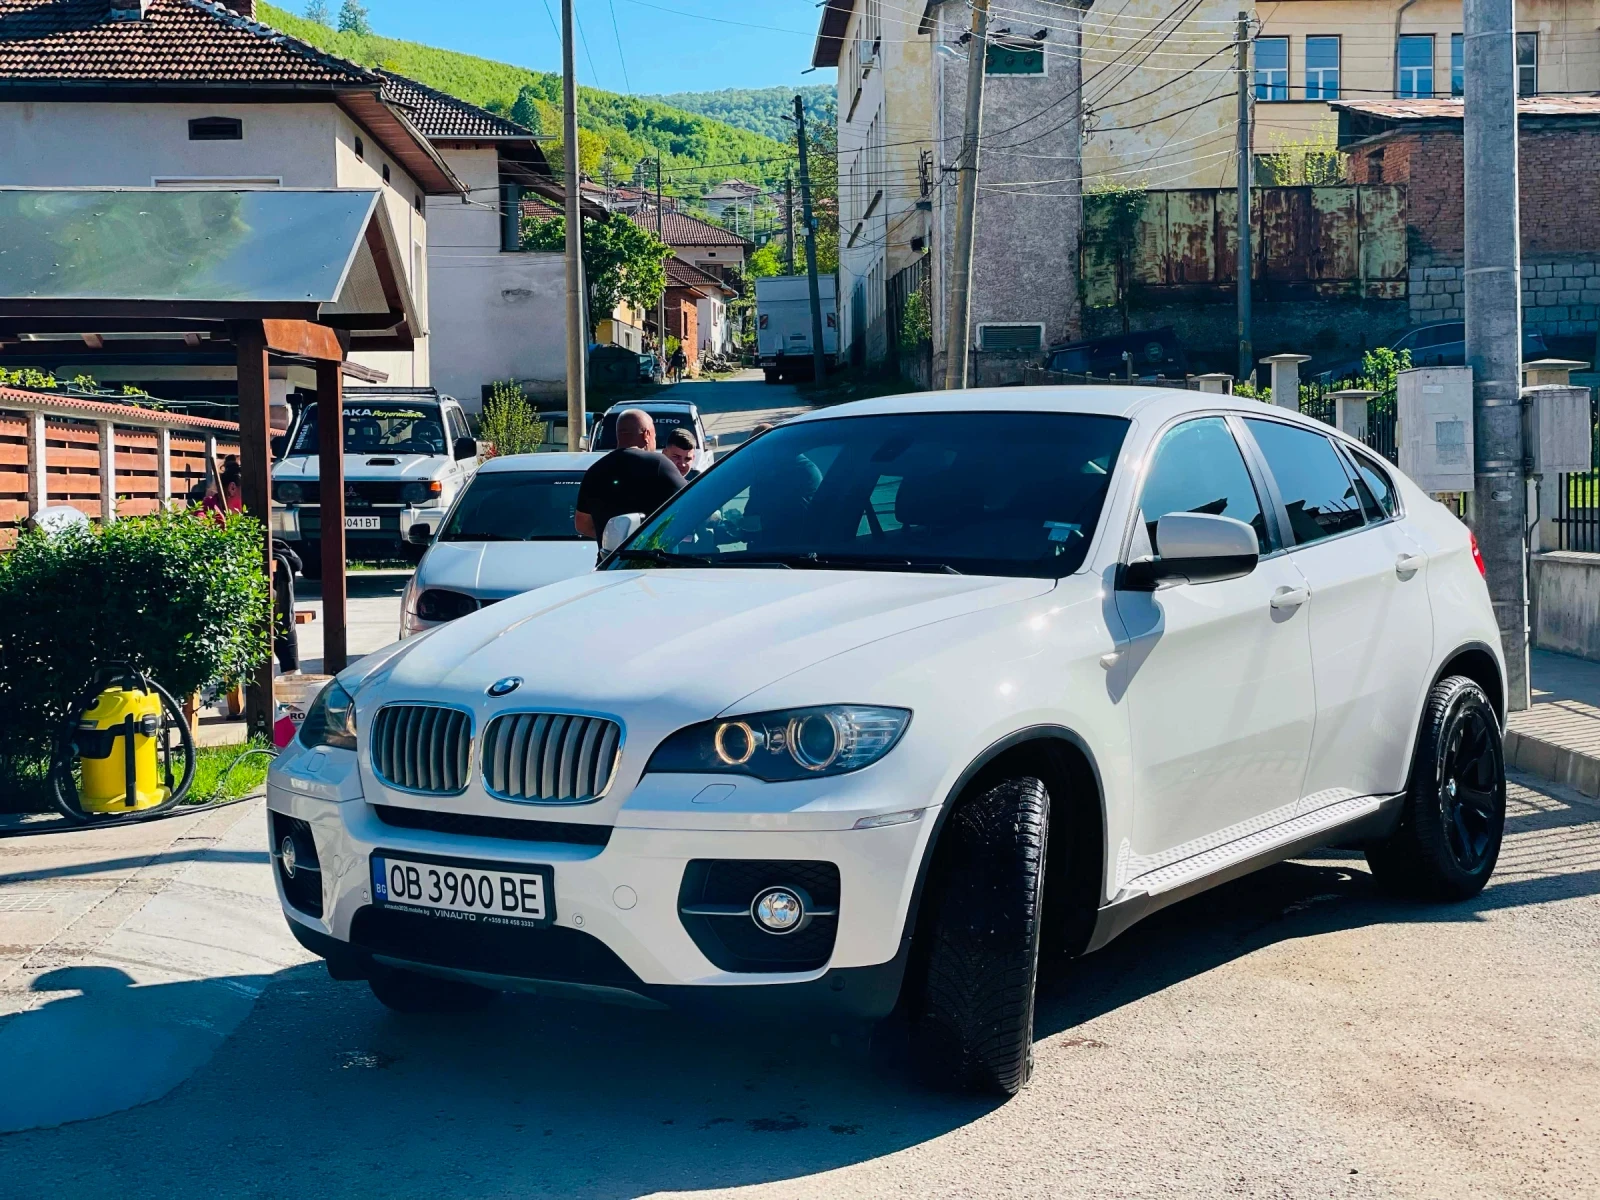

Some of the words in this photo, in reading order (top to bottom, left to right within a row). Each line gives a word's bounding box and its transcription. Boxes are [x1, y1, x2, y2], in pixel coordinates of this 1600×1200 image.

[345, 518, 363, 527] 041
[365, 518, 378, 527] BT
[376, 883, 387, 894] BG
[390, 864, 422, 900] OB
[428, 869, 494, 909] 3900
[499, 876, 540, 914] BE
[434, 909, 476, 921] VINAUTO
